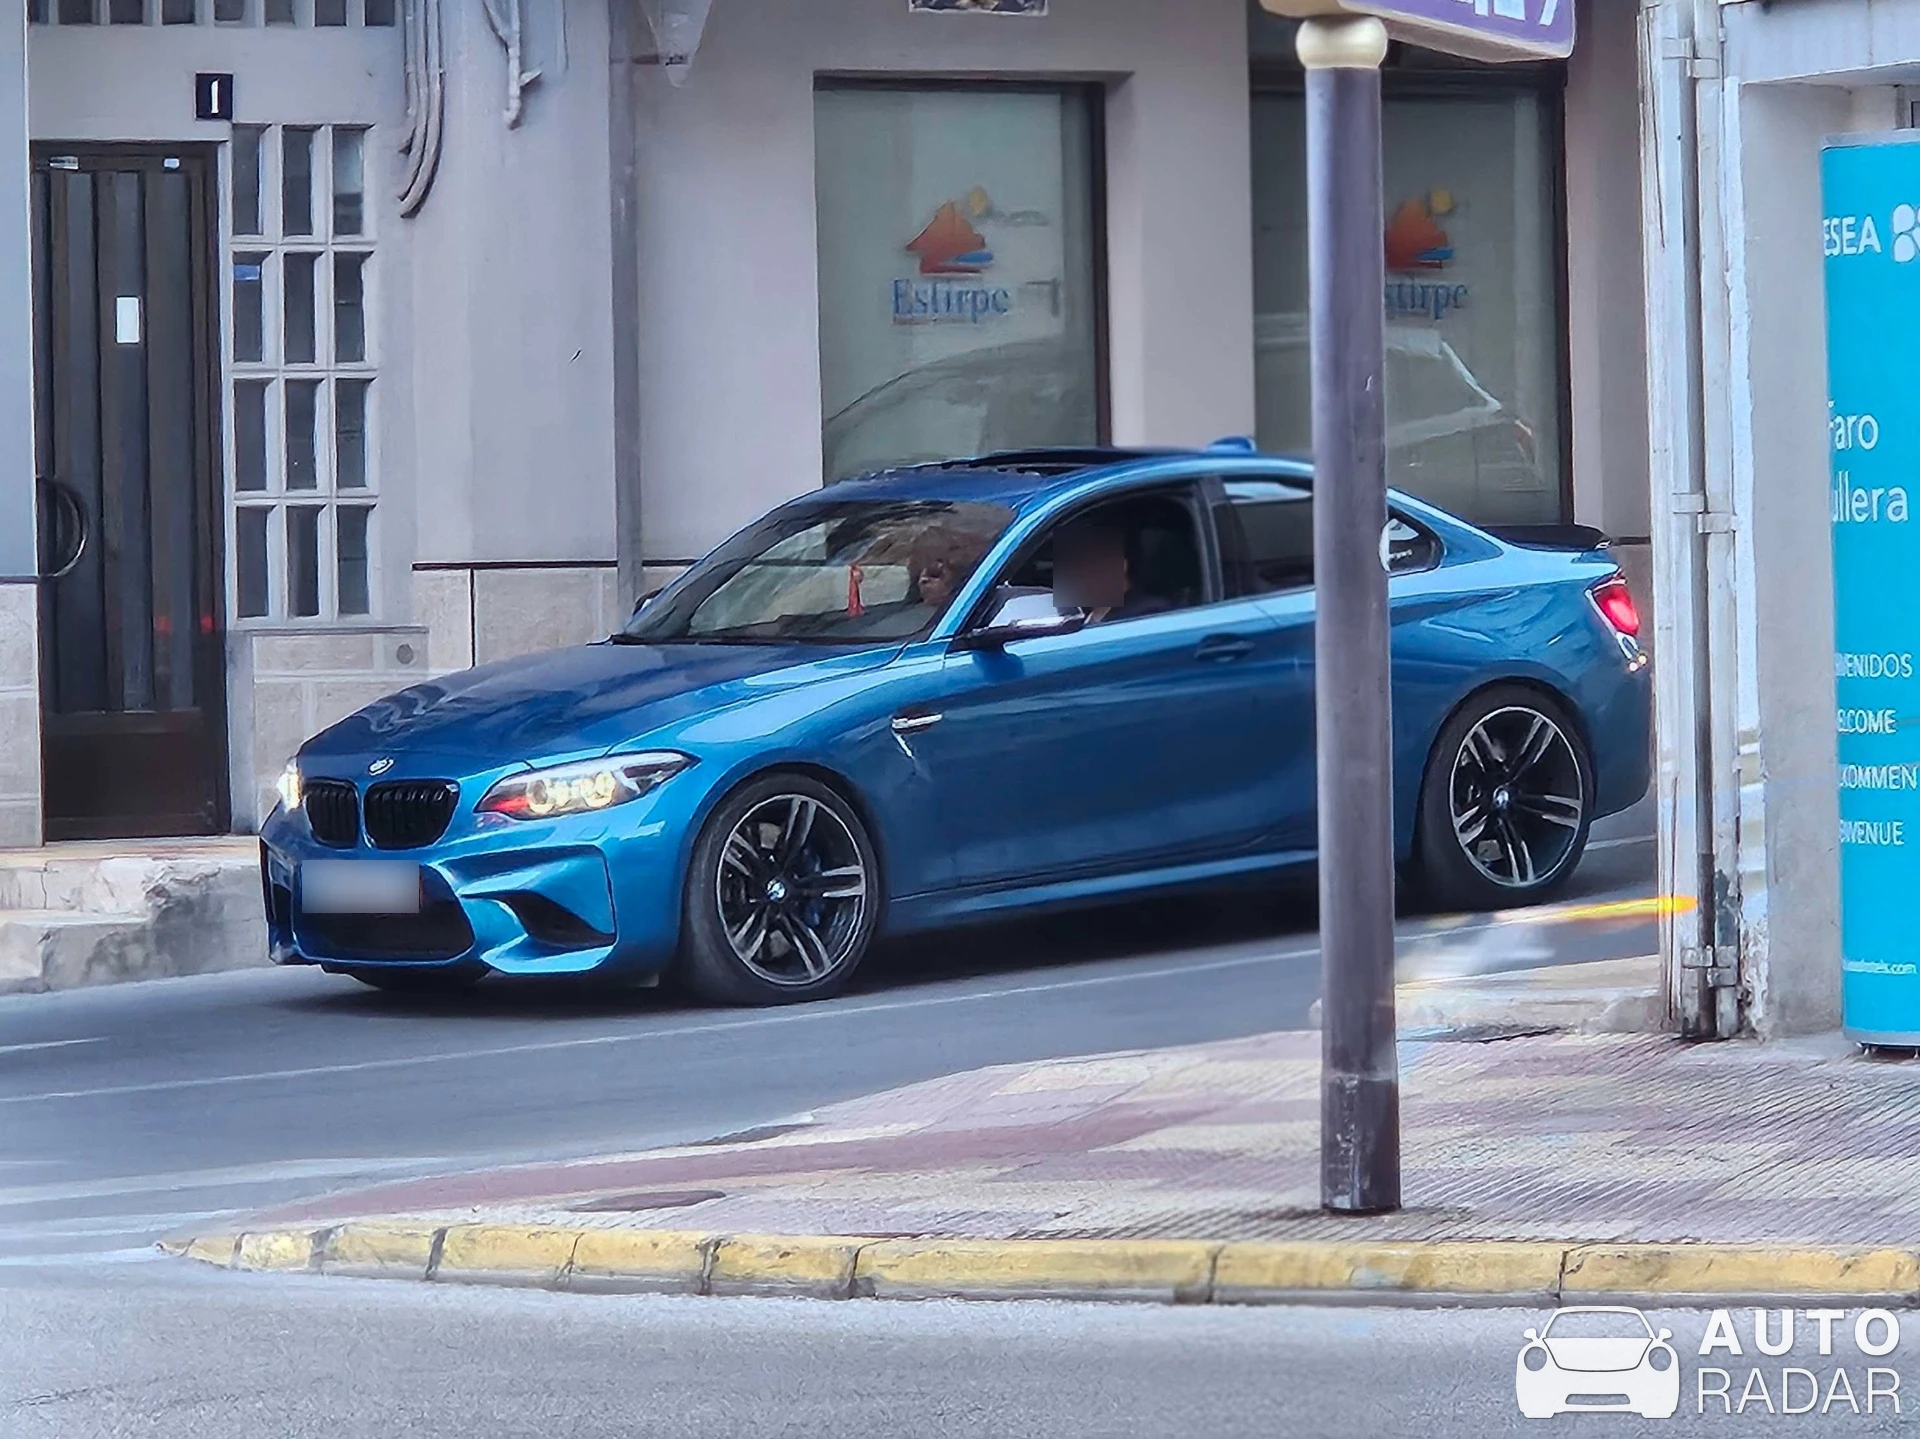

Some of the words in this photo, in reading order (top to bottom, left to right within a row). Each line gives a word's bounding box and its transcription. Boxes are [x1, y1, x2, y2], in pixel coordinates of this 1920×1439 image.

[211, 79, 219, 114] 1
[1823, 216, 1882, 256] ESEA
[893, 278, 1010, 324] Estirpe
[1385, 277, 1468, 320] stirpe
